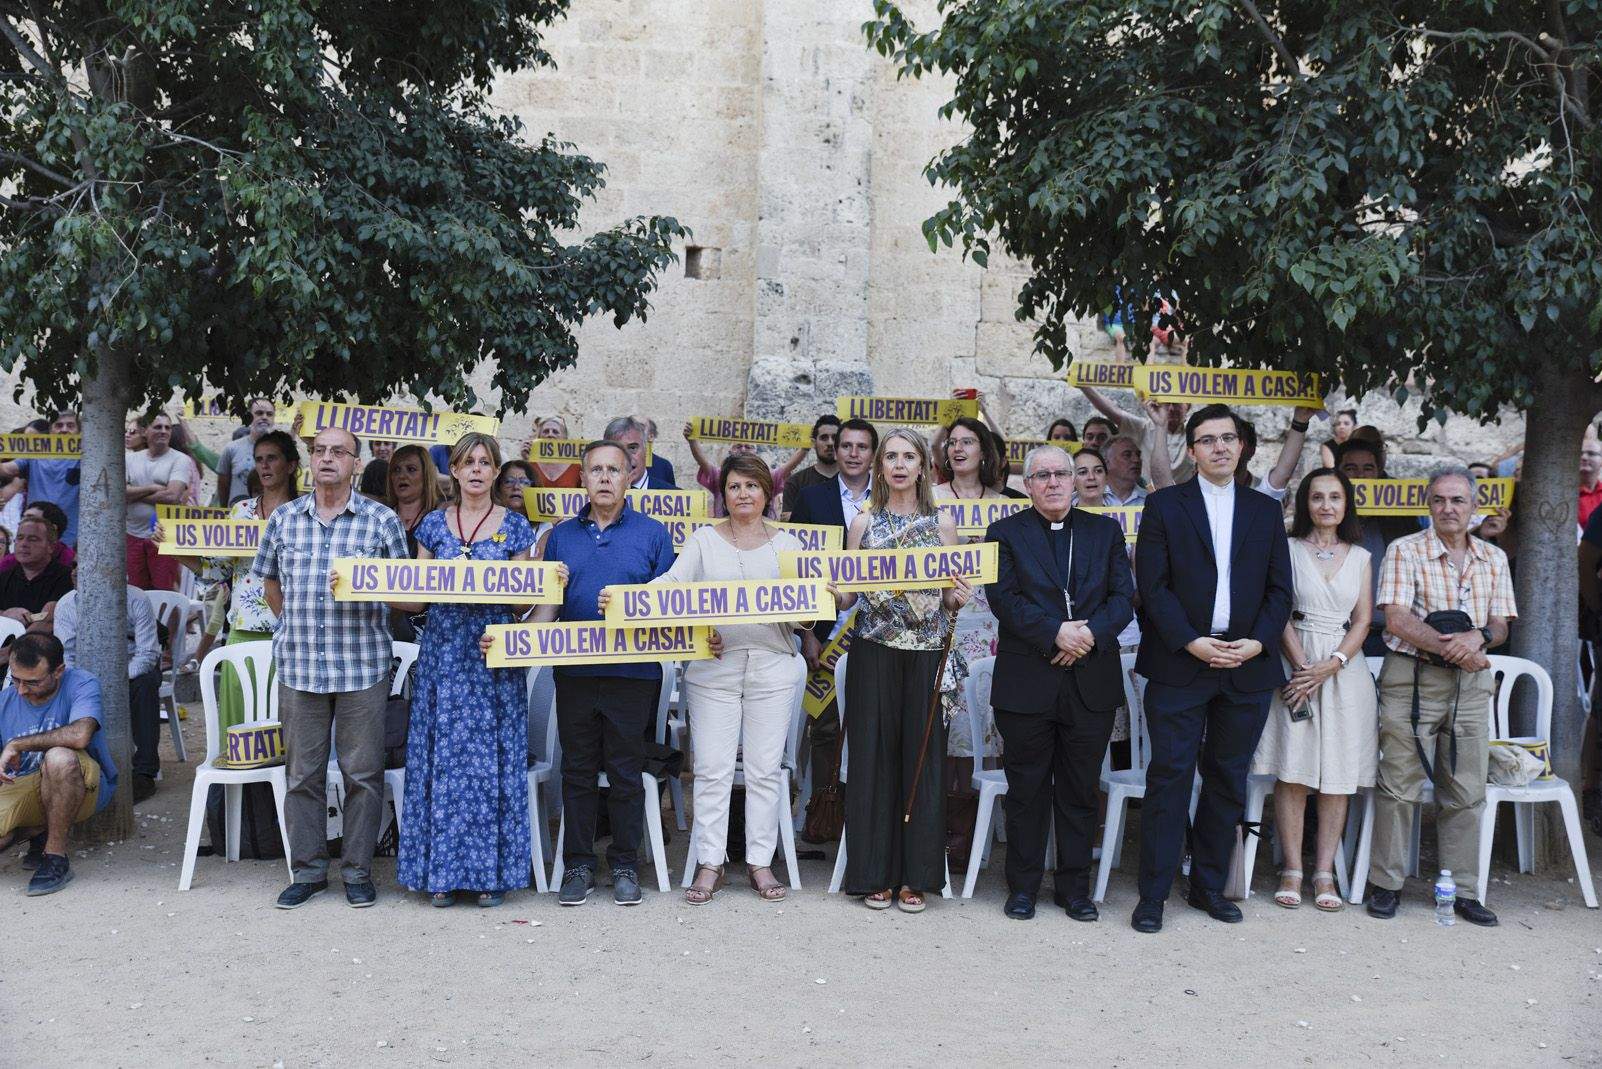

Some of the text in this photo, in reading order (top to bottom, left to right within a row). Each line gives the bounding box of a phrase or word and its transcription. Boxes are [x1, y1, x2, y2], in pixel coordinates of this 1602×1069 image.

[1150, 371, 1172, 393] US
[1178, 372, 1236, 396] VOLEM
[1244, 374, 1256, 396] A
[315, 404, 440, 437] LLIBERTAT!
[850, 399, 938, 420] LLIBERTAT!
[700, 419, 778, 440] LLIBERTAT!
[8, 437, 51, 453] VOLEM
[56, 438, 63, 453] A
[540, 442, 553, 456] US
[536, 493, 556, 514] US
[640, 494, 691, 516] CASA!
[1354, 484, 1366, 506] S
[1478, 484, 1505, 506] SA!
[972, 504, 982, 526] A
[176, 524, 259, 547] US VOLEM
[797, 556, 822, 578] US
[828, 555, 897, 581] VOLEM
[904, 554, 917, 579] A
[924, 550, 981, 577] CASA!
[352, 565, 544, 593] US VOLEM A CASA!
[624, 584, 817, 617] US VOLEM A CASA!
[505, 626, 694, 657] US VOLEM A CASA!
[227, 727, 285, 762] RTAT!
